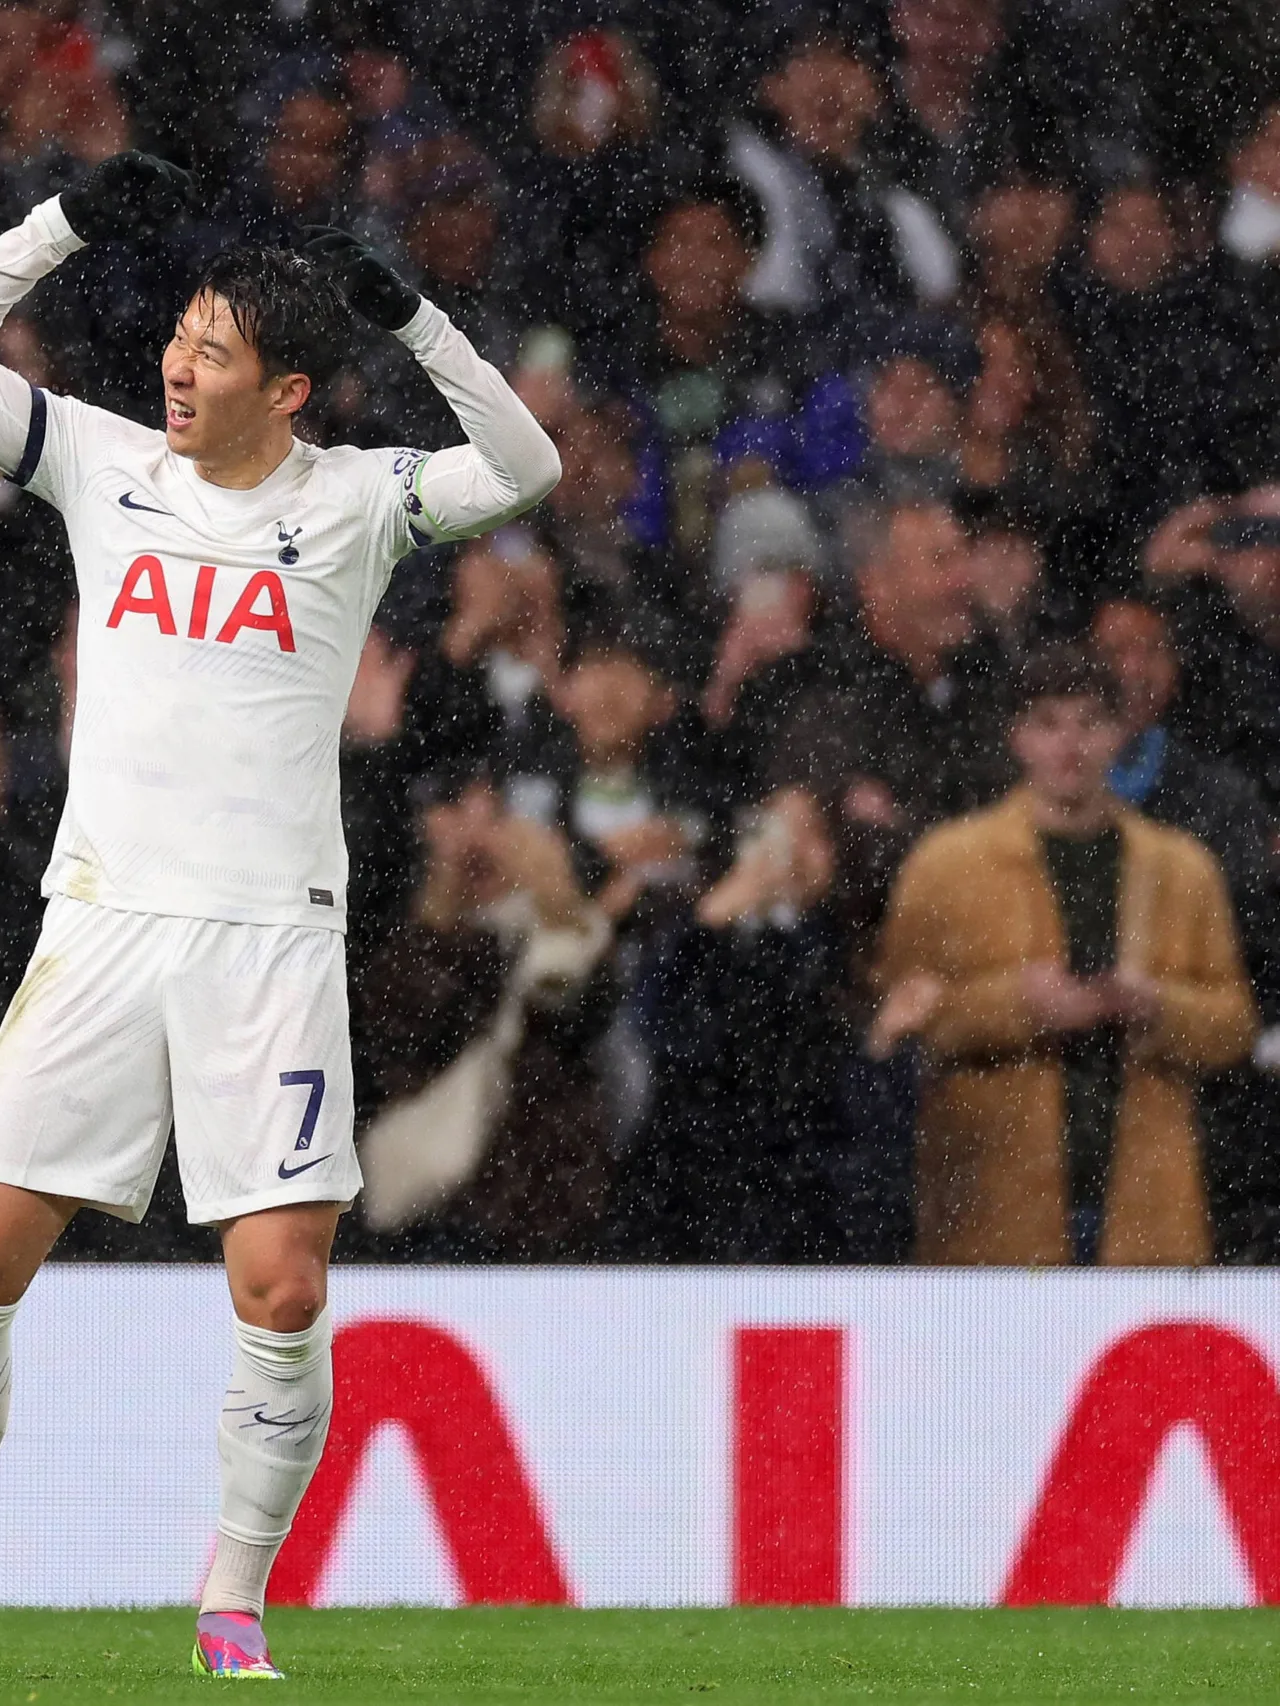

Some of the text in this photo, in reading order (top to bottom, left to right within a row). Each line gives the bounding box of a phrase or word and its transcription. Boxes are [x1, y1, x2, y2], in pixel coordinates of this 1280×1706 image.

[106, 554, 296, 653] AIA
[279, 1069, 326, 1151] 7
[204, 1319, 1280, 1609] AIA
